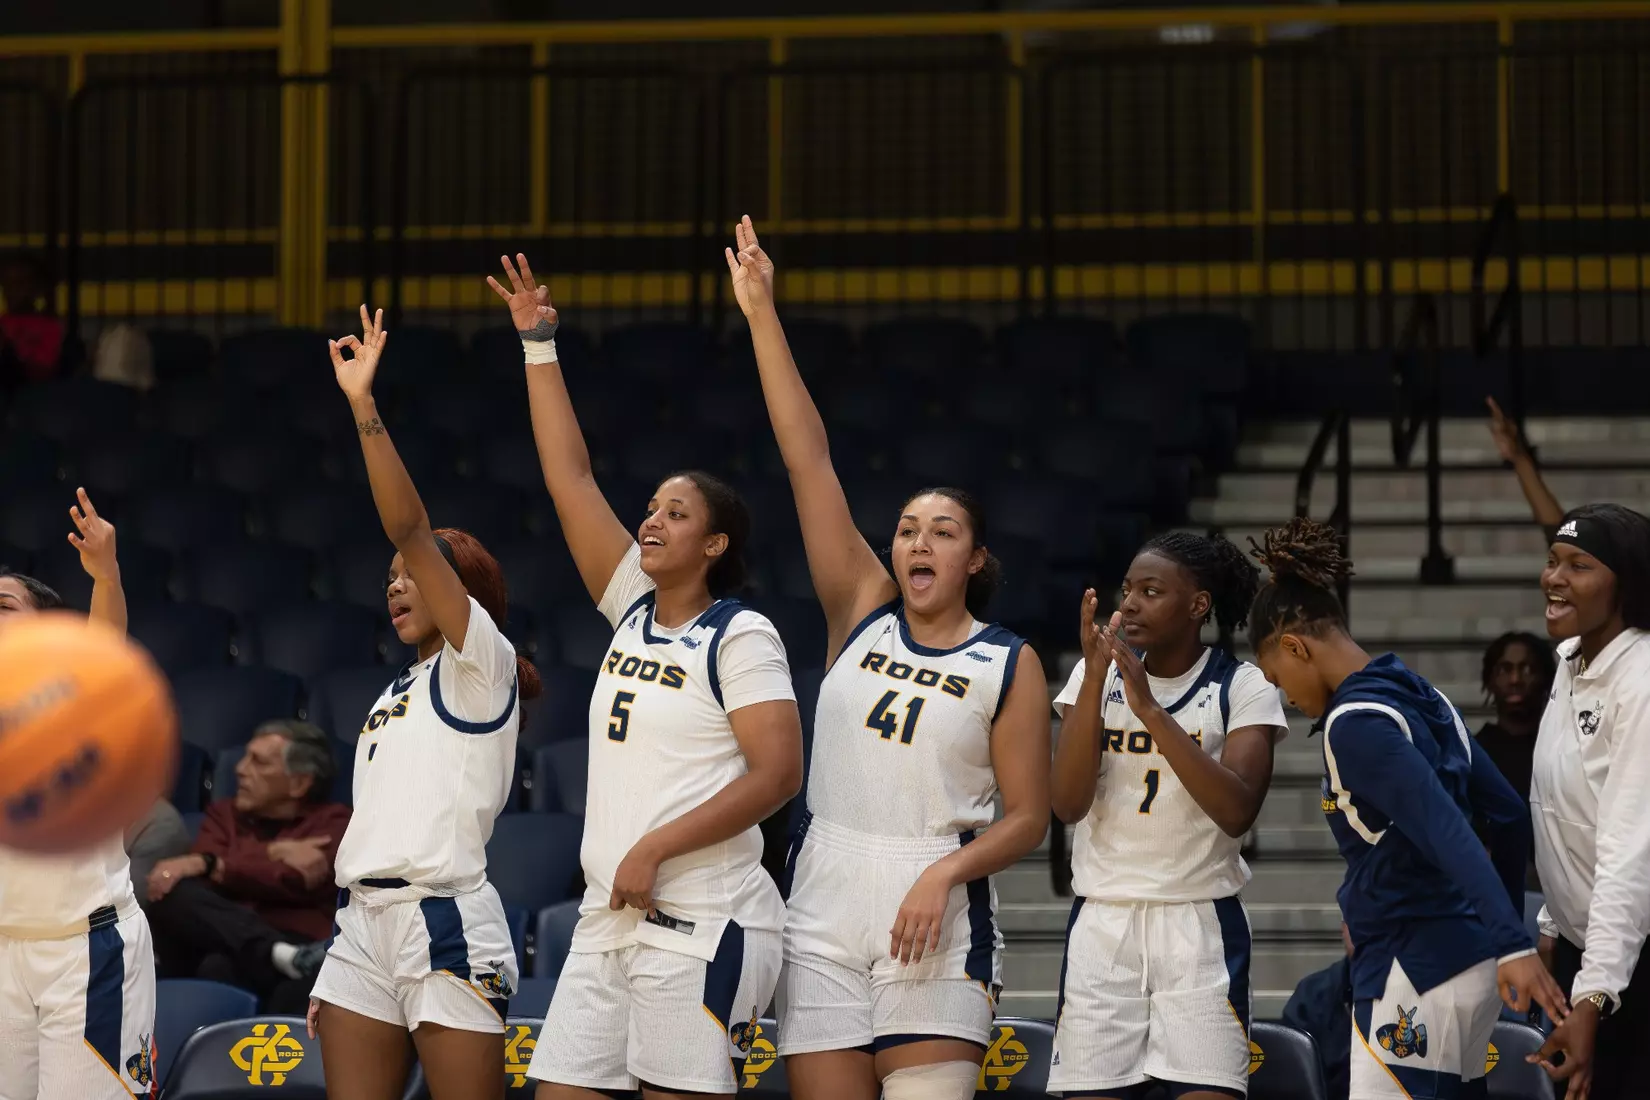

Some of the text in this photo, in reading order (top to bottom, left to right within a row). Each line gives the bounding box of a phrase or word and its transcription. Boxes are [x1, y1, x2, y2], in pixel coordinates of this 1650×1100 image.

[601, 649, 688, 690] ROOS
[859, 650, 971, 701] ROOS
[607, 690, 637, 742] 5
[864, 688, 926, 747] 41
[1102, 727, 1203, 755] RO
[1138, 768, 1160, 815] 1
